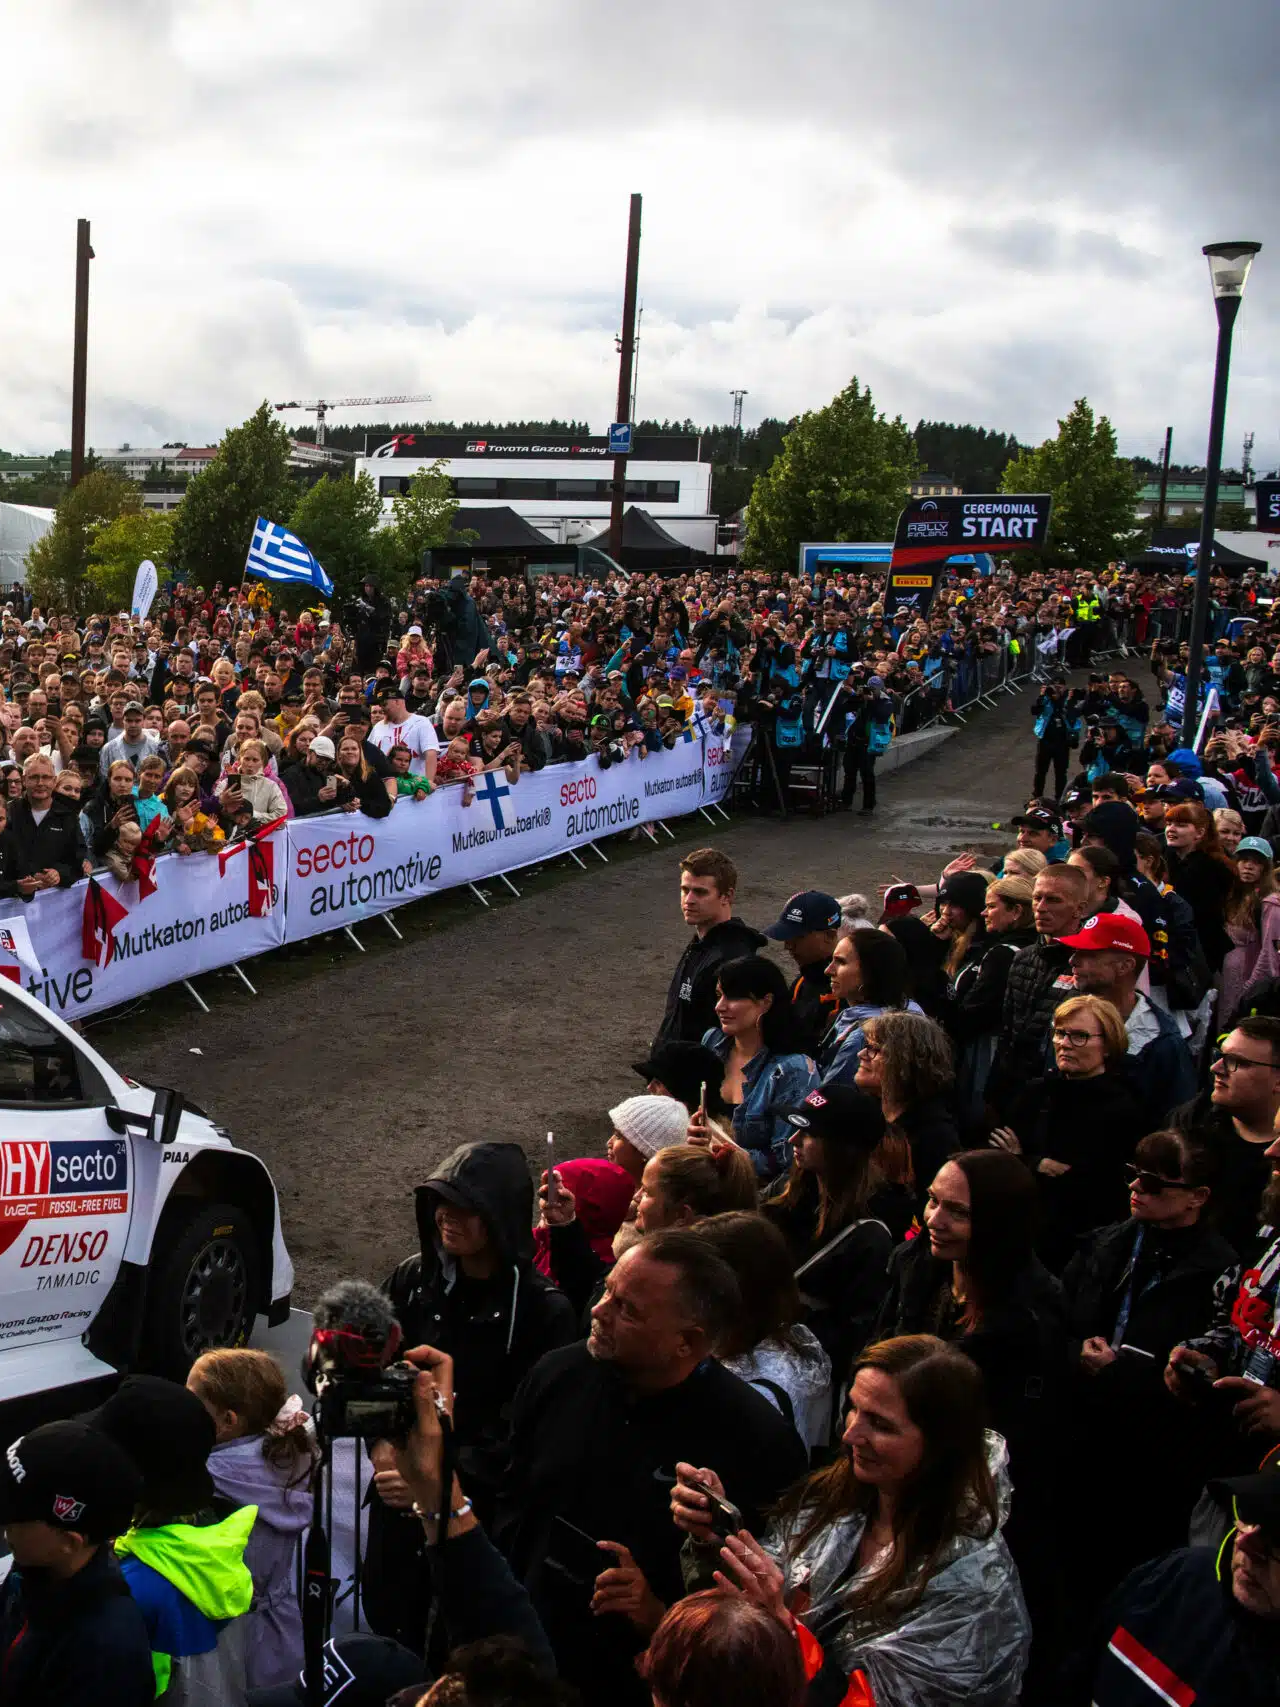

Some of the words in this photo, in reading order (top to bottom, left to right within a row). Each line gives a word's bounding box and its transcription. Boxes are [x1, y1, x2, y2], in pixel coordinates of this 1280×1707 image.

[466, 441, 487, 453] GR
[531, 445, 569, 453] GAZOO
[571, 445, 607, 455] Racing
[962, 503, 1038, 514] CEREMONIAL
[907, 522, 949, 532] RALLY
[962, 517, 1038, 538] START
[560, 773, 597, 807] secto
[566, 794, 640, 838] automotive
[296, 831, 375, 878] secto
[310, 851, 442, 917] automotive
[113, 914, 206, 962] Mutkaton
[163, 1151, 190, 1163] PIAA
[5, 1143, 47, 1195] HY
[56, 1150, 117, 1183] secto
[49, 1199, 102, 1214] FOSSIL-FREE
[103, 1198, 122, 1210] FUEL
[20, 1230, 108, 1268] DENSO
[36, 1270, 100, 1290] TAMADIC
[26, 1313, 60, 1325] GAZOO
[60, 1310, 92, 1320] Racing
[6, 1327, 37, 1339] Challenge
[37, 1324, 62, 1333] Program
